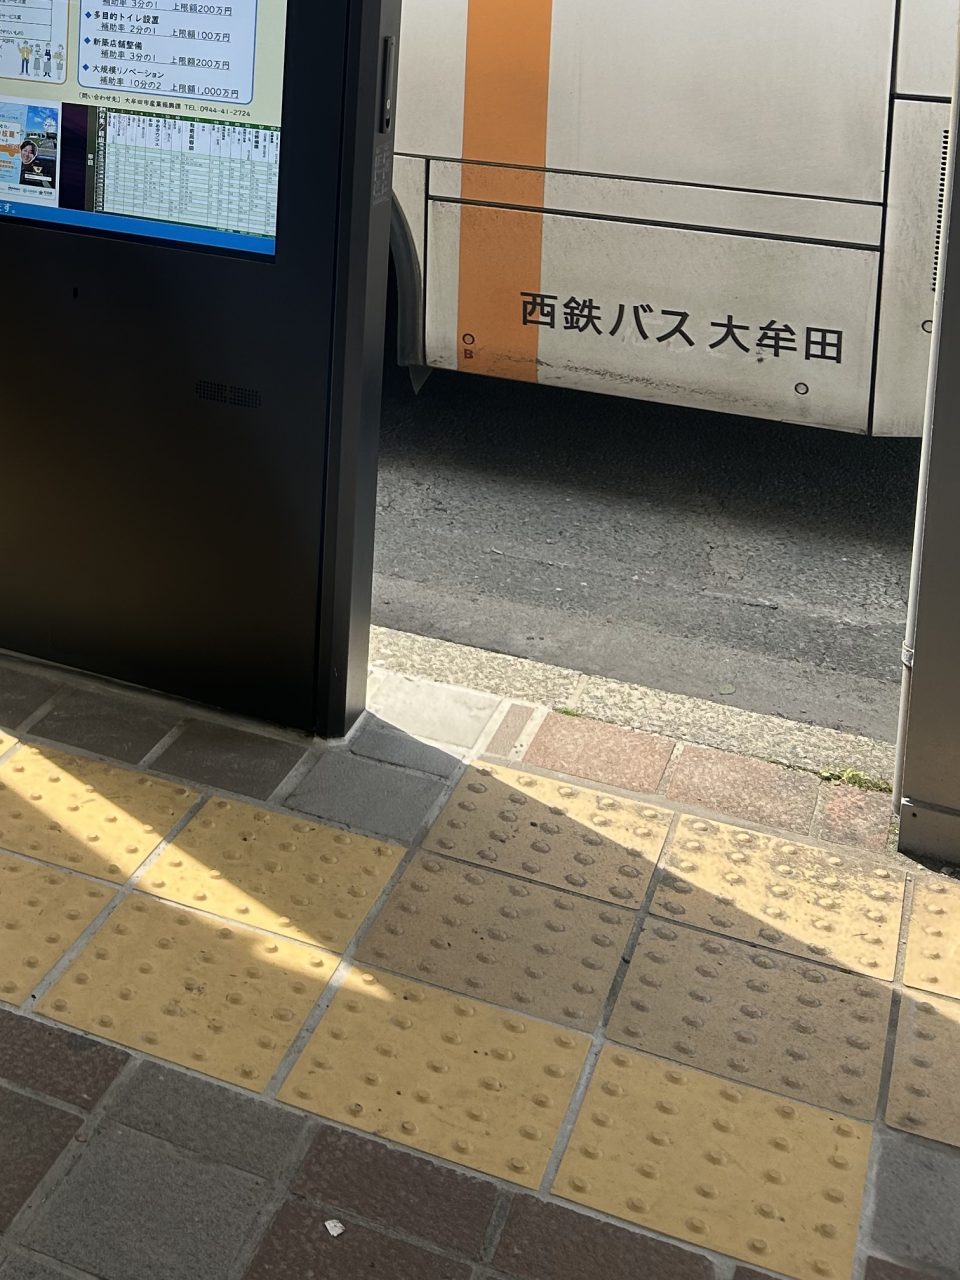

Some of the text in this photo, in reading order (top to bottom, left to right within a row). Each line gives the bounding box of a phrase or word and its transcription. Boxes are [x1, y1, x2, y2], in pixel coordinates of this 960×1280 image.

[132, 0, 158, 8] 3分の1
[173, 2, 232, 15] 上限額200万円
[94, 11, 159, 24] 多目的トイレ設置
[101, 23, 231, 42] 補助率 2分の1 上限額100万円
[93, 38, 142, 50] 新築店舗整備
[101, 50, 230, 69] 補助率 3分の1 上限額200万円
[93, 65, 164, 78] 大規模リノベーション
[100, 76, 239, 98] 補助率 10分の2 上限額1,000万円
[520, 291, 843, 363] 西鉄バス大牟田
[464, 348, 473, 359] B
